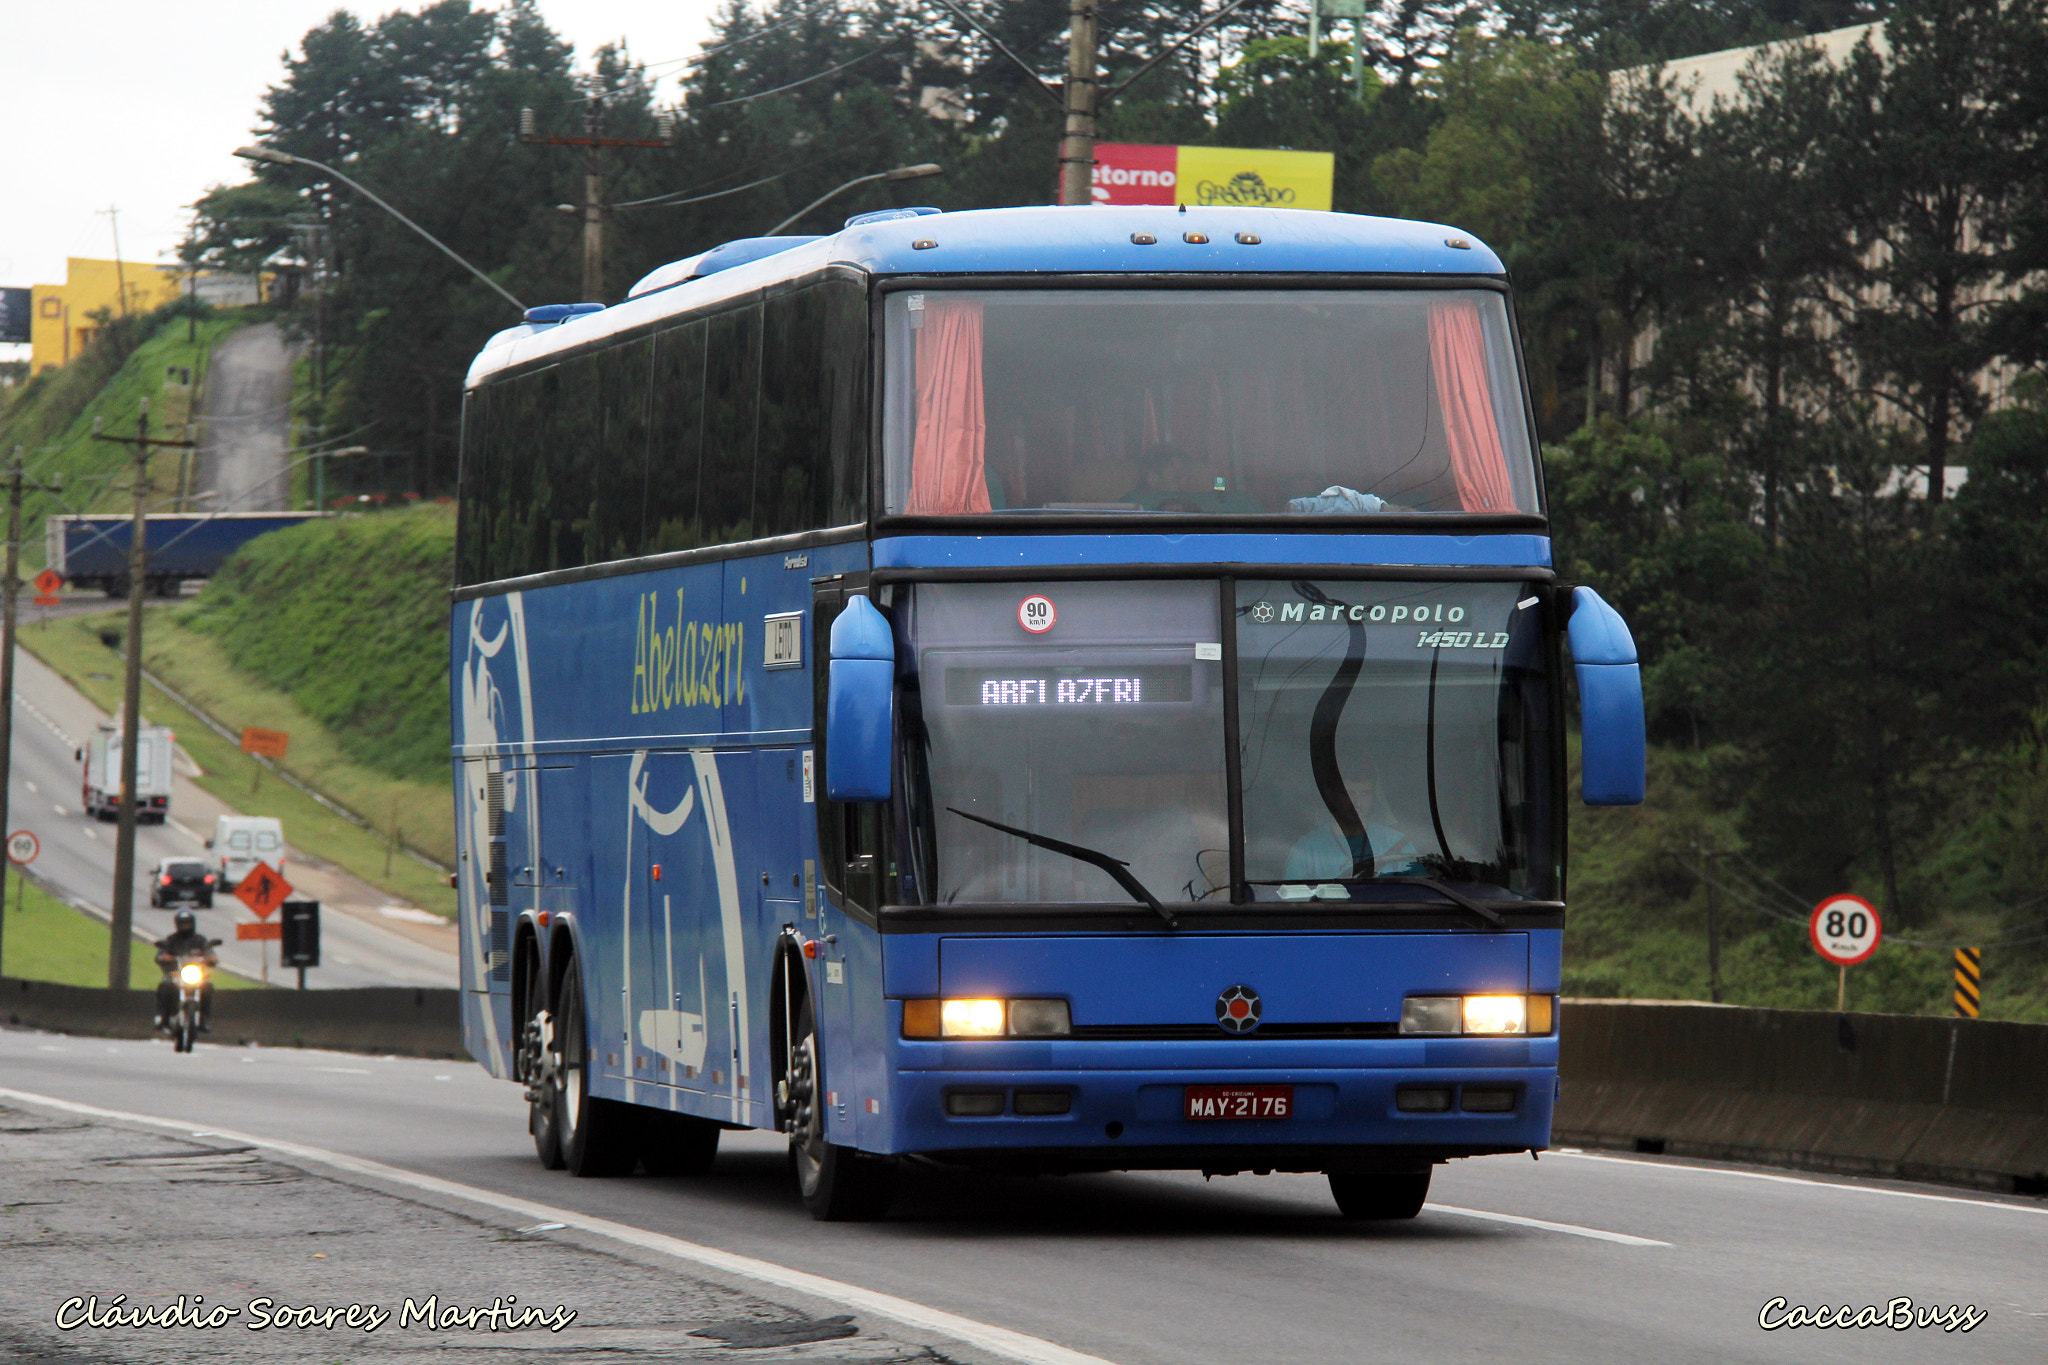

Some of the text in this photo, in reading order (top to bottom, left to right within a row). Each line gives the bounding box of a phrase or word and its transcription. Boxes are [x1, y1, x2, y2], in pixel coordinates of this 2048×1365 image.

[1092, 164, 1176, 187] etorno
[1027, 602, 1047, 617] 90
[1280, 602, 1466, 622] Marcopolo
[1029, 618, 1046, 626] km/h
[632, 577, 746, 714] Abelazeri
[1416, 631, 1510, 648] 1450 LD
[1826, 911, 1867, 938] 80
